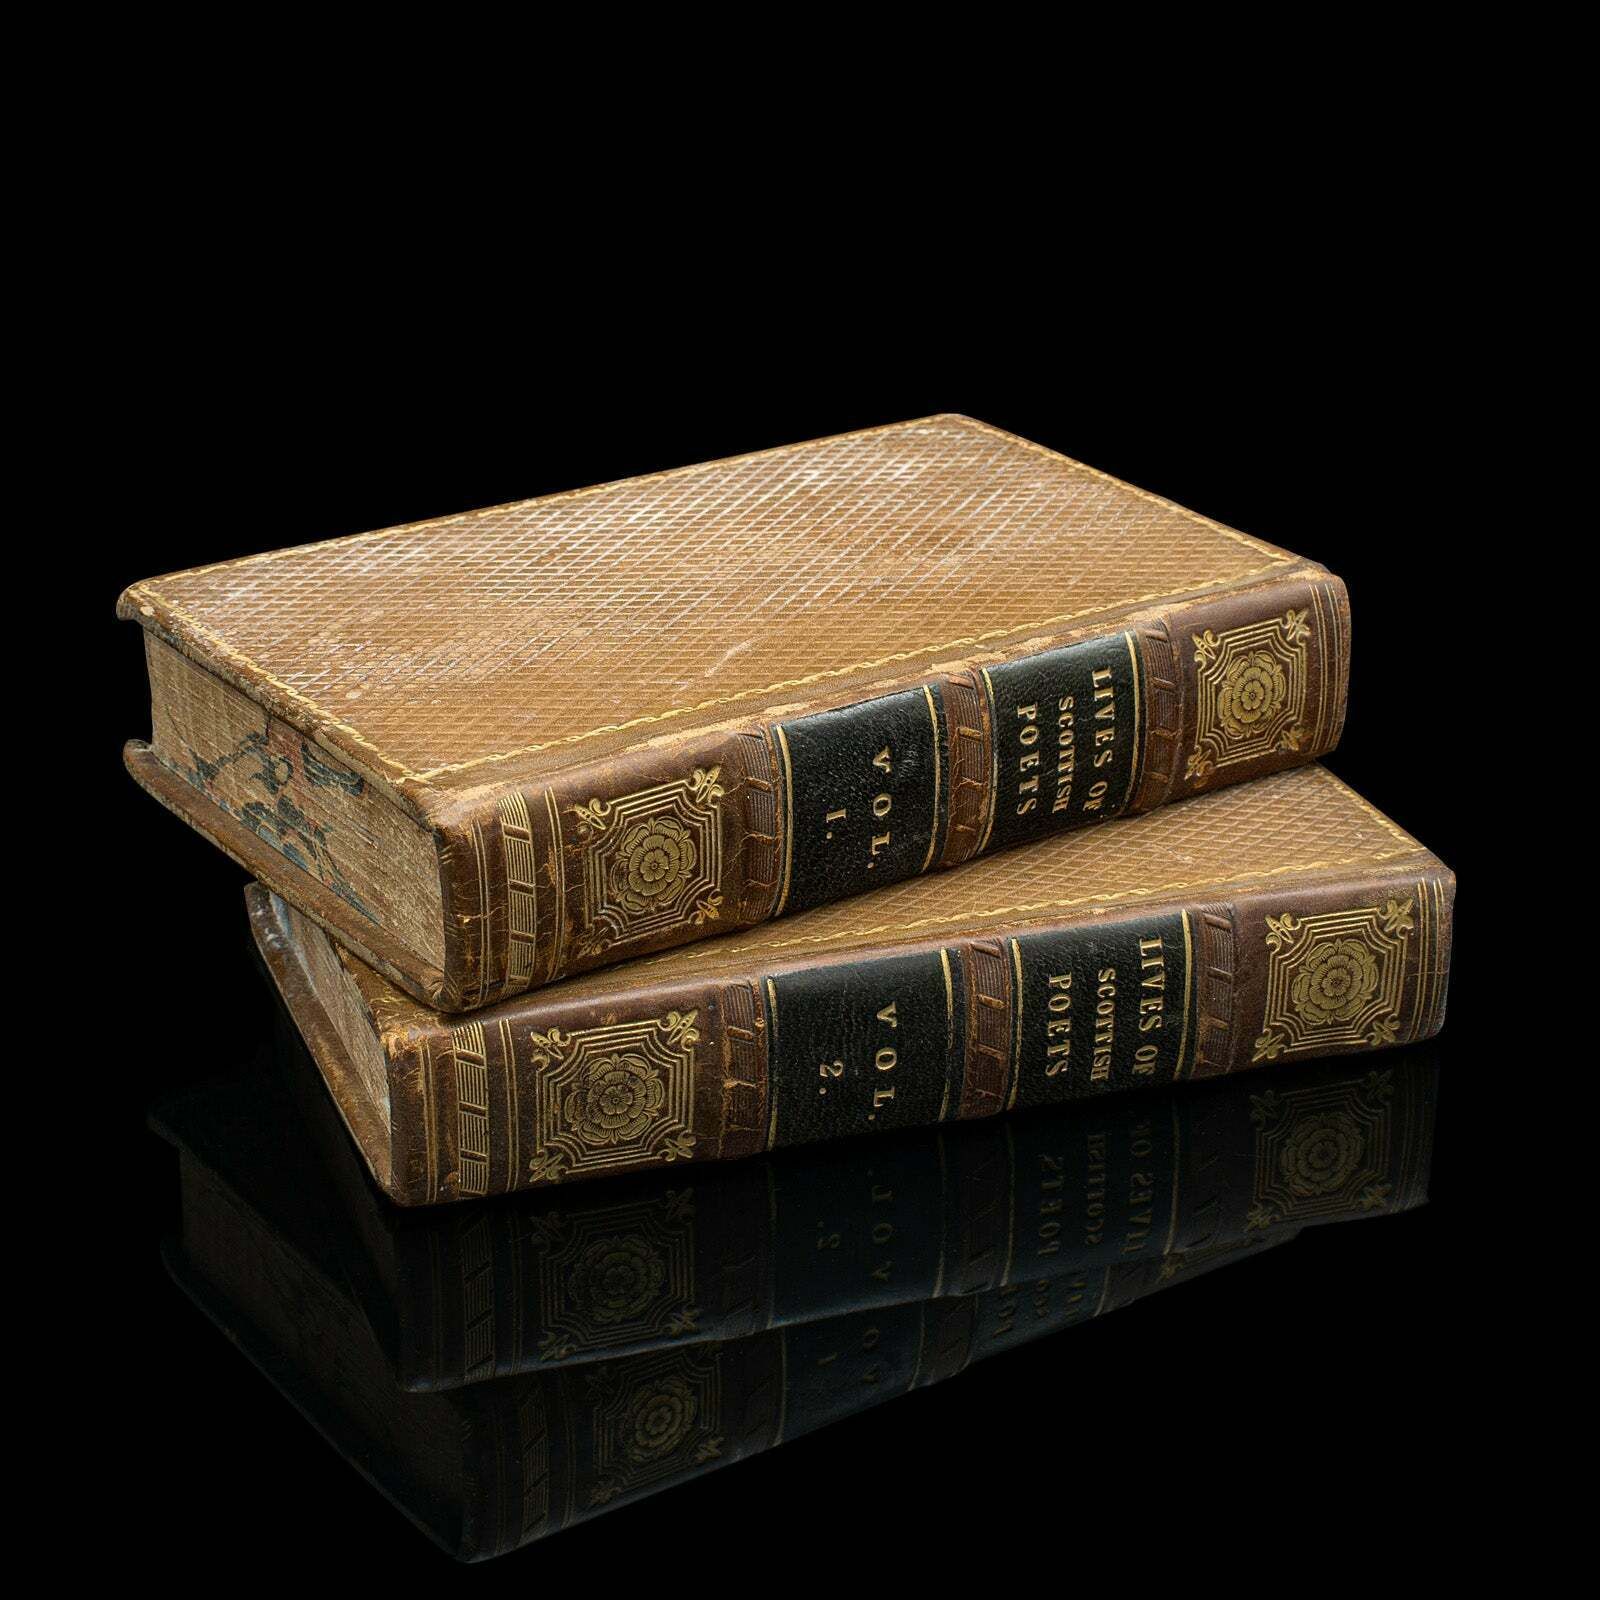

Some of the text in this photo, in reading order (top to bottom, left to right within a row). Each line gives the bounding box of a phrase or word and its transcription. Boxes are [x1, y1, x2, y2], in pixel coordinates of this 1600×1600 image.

[1017, 701, 1040, 816] POETS
[1052, 695, 1076, 814] SCOTTISH
[1083, 665, 1116, 812] LIVES OF
[826, 808, 847, 840] 1.
[867, 744, 893, 870] VOL.
[868, 1001, 897, 1121] VOL.
[1044, 973, 1072, 1078] POETS
[1090, 967, 1116, 1082] SCOTTISH
[1132, 935, 1165, 1076] LIVES OF
[818, 1059, 844, 1096] 2.
